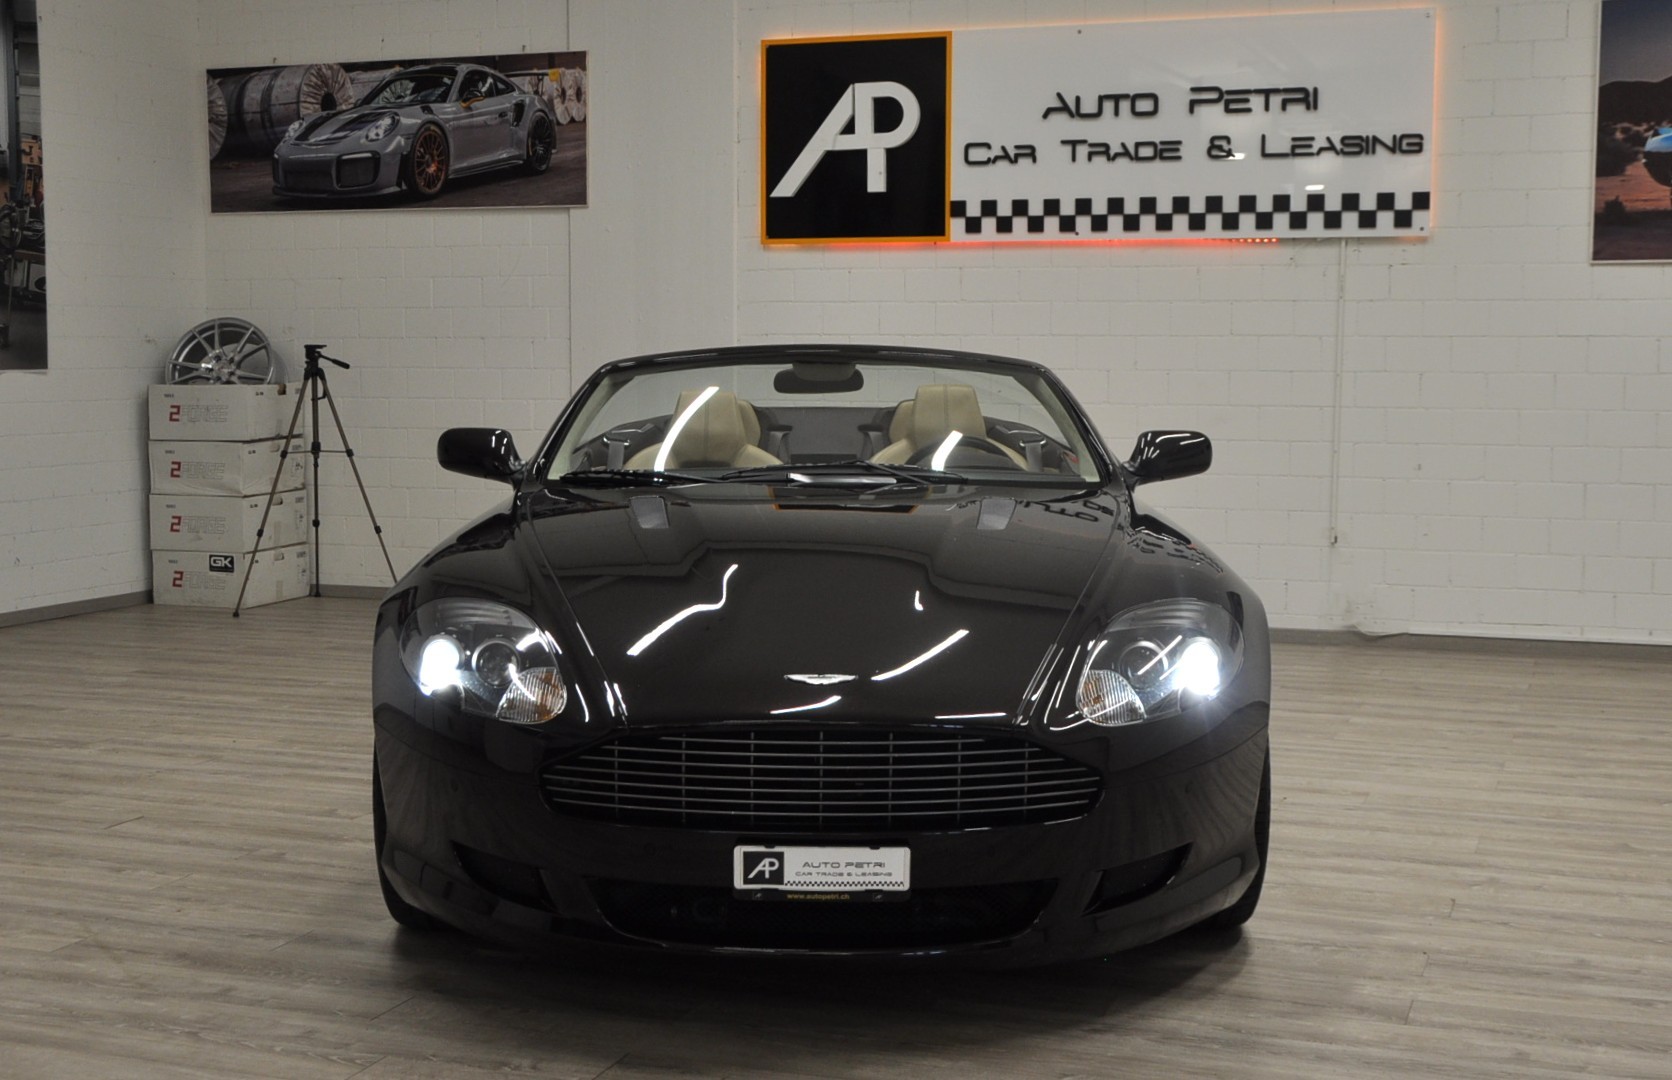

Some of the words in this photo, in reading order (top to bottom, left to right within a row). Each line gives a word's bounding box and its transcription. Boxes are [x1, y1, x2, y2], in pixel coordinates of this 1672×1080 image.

[1042, 90, 1160, 119] AUTO
[1188, 86, 1319, 115] PETRI
[769, 81, 921, 197] AP
[963, 141, 1037, 166] CAR
[1060, 138, 1183, 163] TRADE
[1206, 135, 1236, 158] &
[1260, 132, 1425, 158] LEASING
[210, 556, 233, 568] GK
[747, 857, 780, 879] AP
[786, 893, 850, 901] www.autopetri.ch
